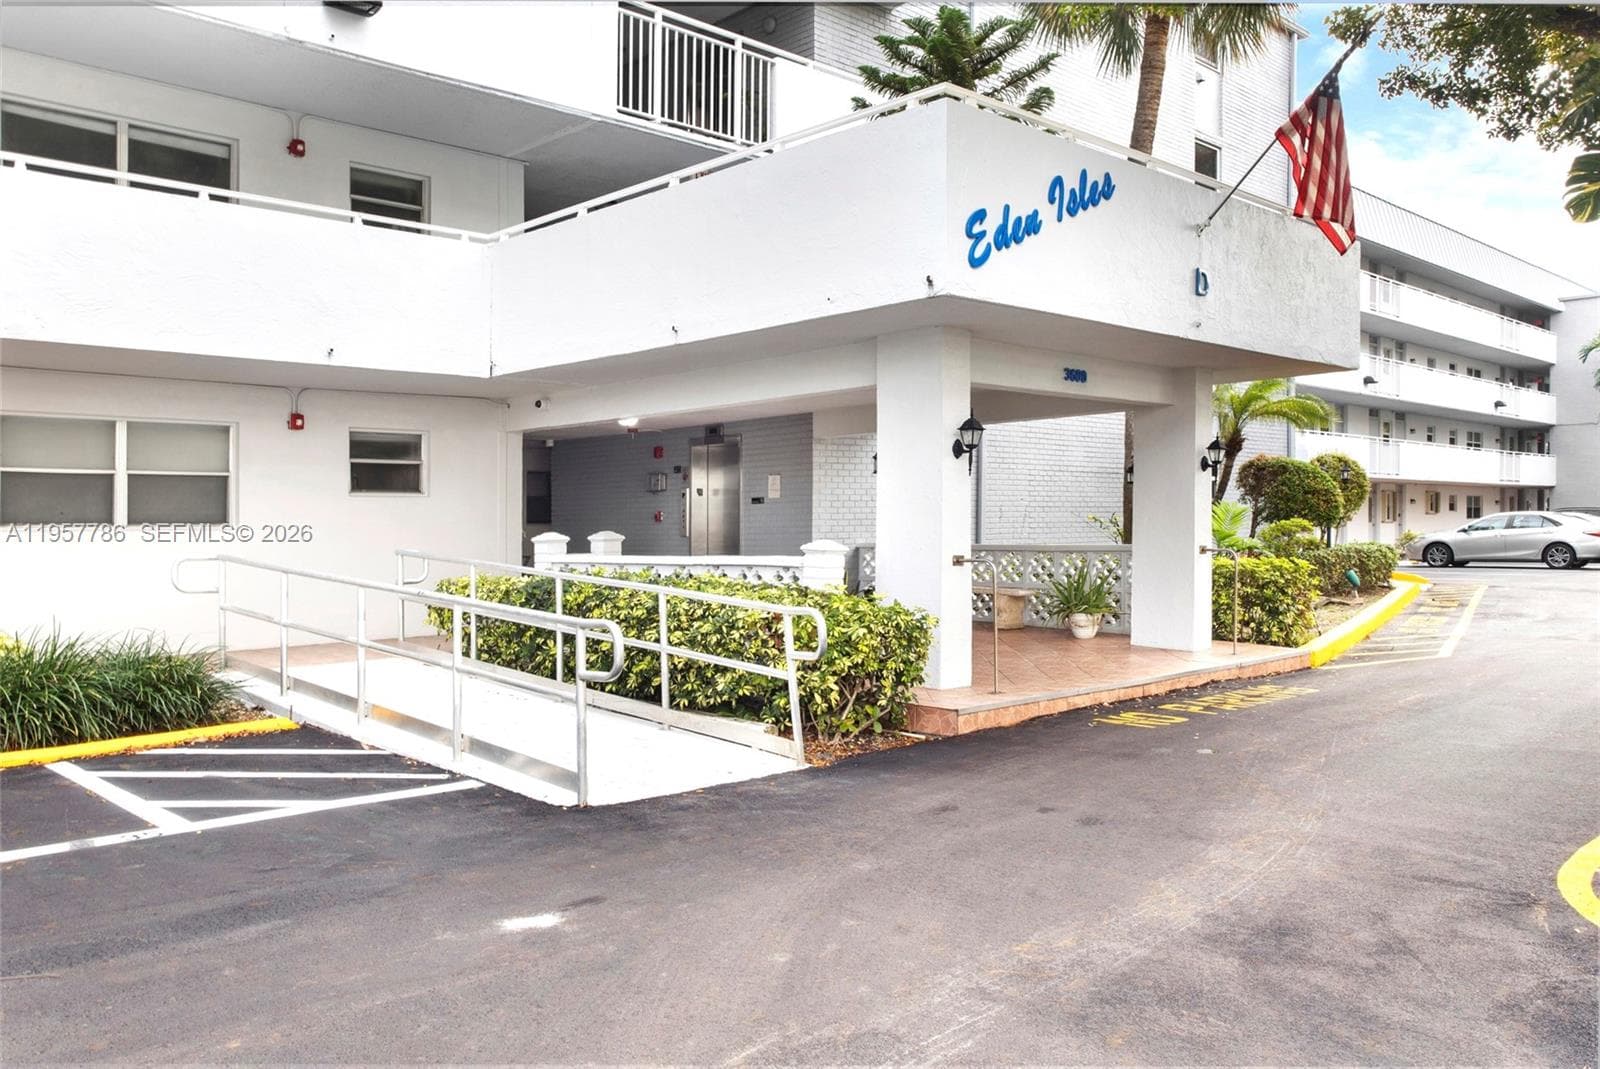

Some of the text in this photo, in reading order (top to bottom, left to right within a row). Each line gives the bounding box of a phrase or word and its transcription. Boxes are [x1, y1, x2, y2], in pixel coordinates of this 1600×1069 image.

[965, 168, 1116, 269] Eden Isles
[1093, 711, 1189, 729] NO
